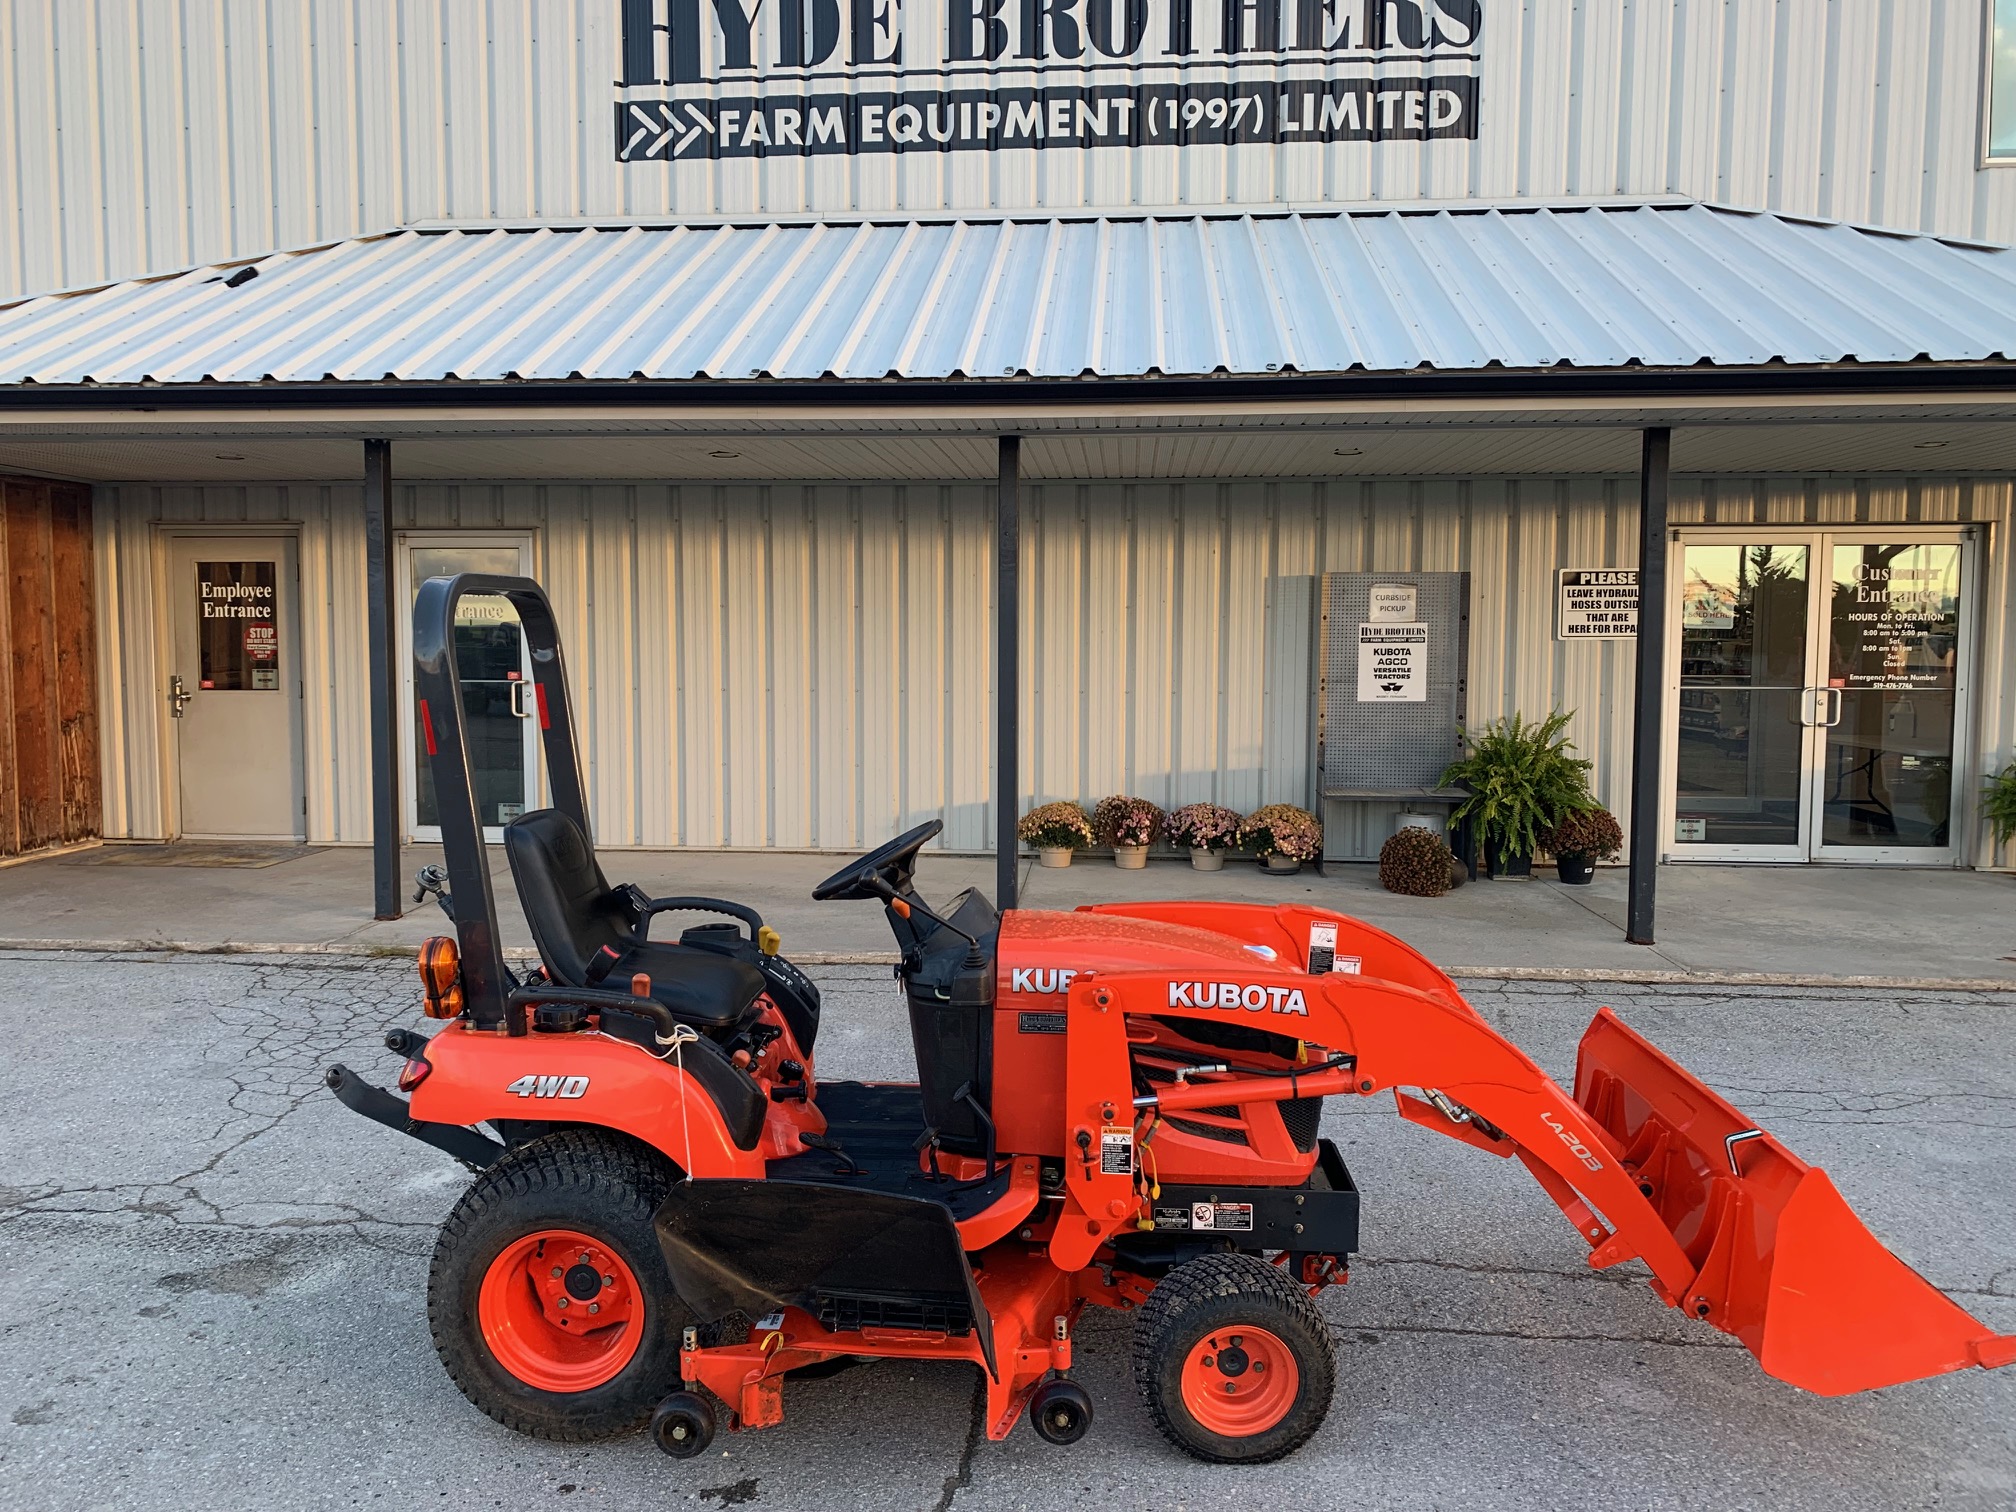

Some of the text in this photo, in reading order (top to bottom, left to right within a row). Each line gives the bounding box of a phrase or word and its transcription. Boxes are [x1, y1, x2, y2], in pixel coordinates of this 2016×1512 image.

[614, 0, 902, 87] HYDE
[719, 89, 1462, 146] FARM EQUIPMENT (1997) LIMITED
[1580, 572, 1636, 585] PLEASE
[201, 582, 272, 601] Employee
[1567, 589, 1639, 598] LEAVE HYDRAUL
[1856, 586, 1939, 603] Entrance
[203, 602, 271, 618] Entrance
[1571, 600, 1638, 609] HOSES OUTSID
[1586, 613, 1629, 622] THAT ARE
[1848, 613, 1945, 622] HOURS OF OPERATION
[249, 628, 274, 638] STOP
[1361, 627, 1426, 637] HYDE BROTHERS
[1568, 625, 1591, 633] HERE
[1593, 625, 1611, 633] FOR
[1373, 648, 1412, 656] KUBOTA
[1377, 658, 1408, 666] AGCO
[1849, 674, 1886, 682] Emergency
[1910, 674, 1938, 682] Number
[1012, 967, 1099, 994] KUB
[1168, 982, 1307, 1016] KUBOTA
[506, 1075, 590, 1099] 4WD
[1540, 1111, 1604, 1172] LA203
